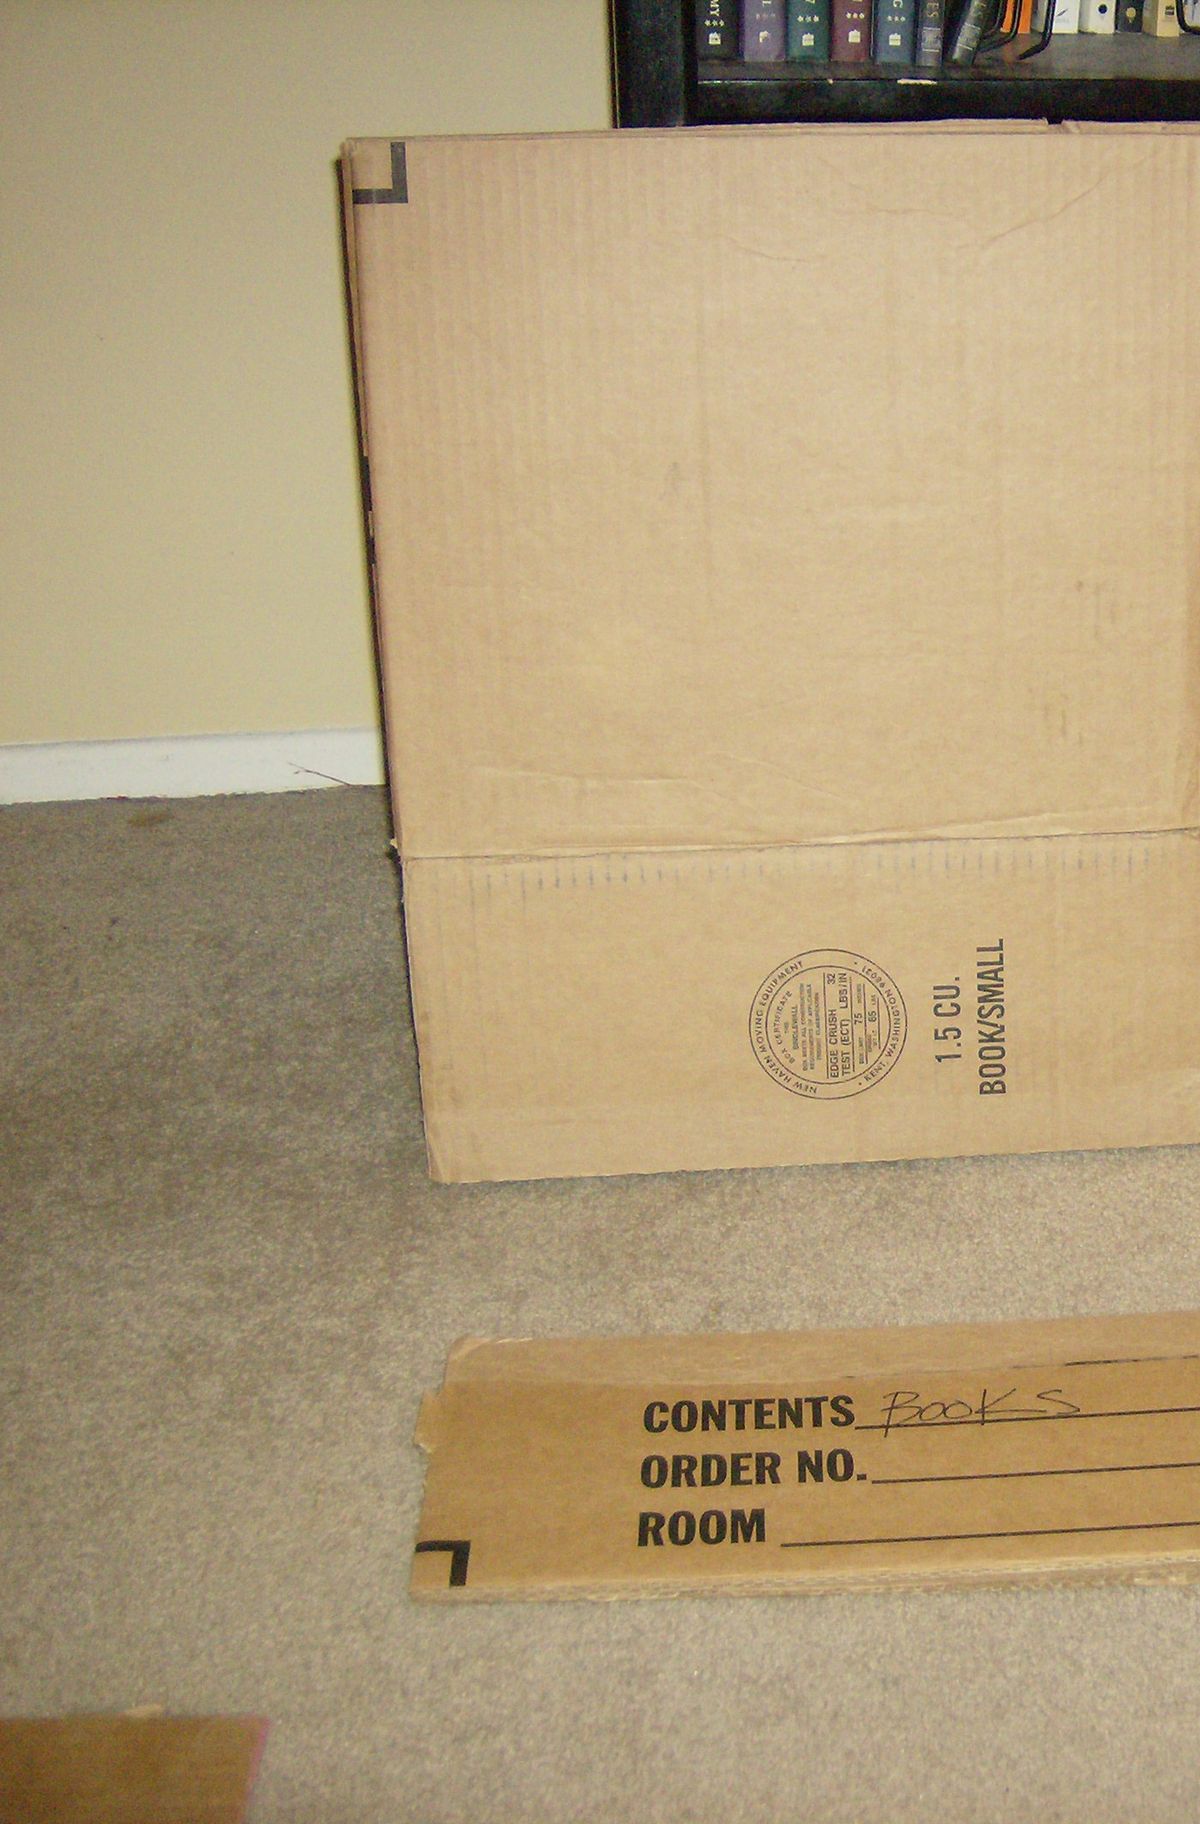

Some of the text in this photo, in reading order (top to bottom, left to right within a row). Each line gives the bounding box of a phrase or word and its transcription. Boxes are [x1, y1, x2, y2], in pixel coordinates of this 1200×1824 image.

[759, 961, 803, 1007] EQUIPMENT
[755, 1009, 768, 1052] MOVING
[827, 973, 839, 1078] EDGE CRUSH 32
[840, 1019, 851, 1046] (ECT)
[854, 1013, 862, 1025] 75
[868, 1011, 876, 1022] 65
[885, 989, 901, 1057] WASHINGTON
[933, 976, 963, 1064] 1.5 CU.
[976, 938, 1007, 1096] BOOK/SMALL
[764, 1055, 791, 1082] HAVEN
[841, 1051, 851, 1076] TEST
[642, 1395, 856, 1433] CONTENTS
[640, 1448, 868, 1489] ORDER NO.
[637, 1508, 767, 1547] ROOM
